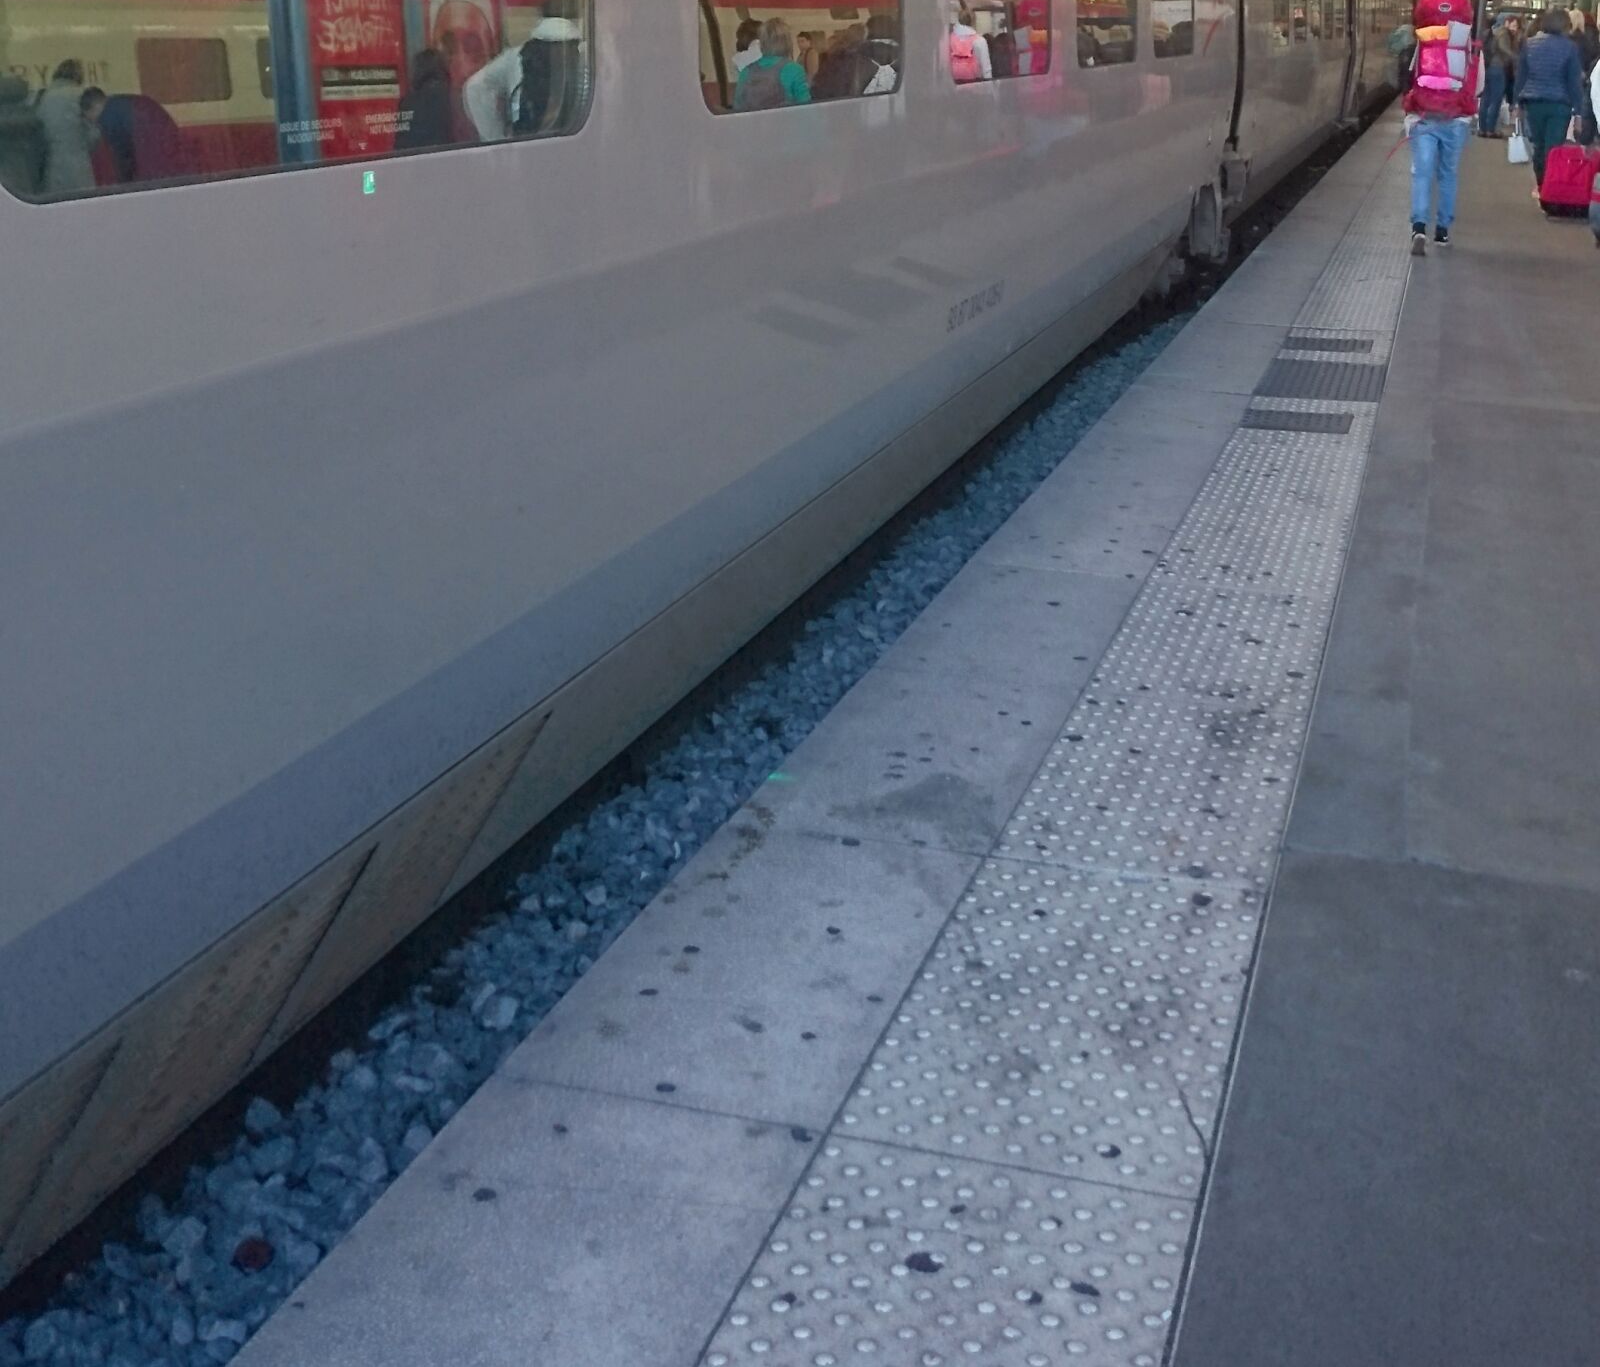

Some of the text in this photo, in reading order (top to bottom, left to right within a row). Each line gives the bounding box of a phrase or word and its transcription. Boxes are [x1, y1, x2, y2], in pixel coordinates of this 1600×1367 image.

[401, 110, 414, 121] EXIT
[279, 117, 342, 133] ISSUE DE SECOURS
